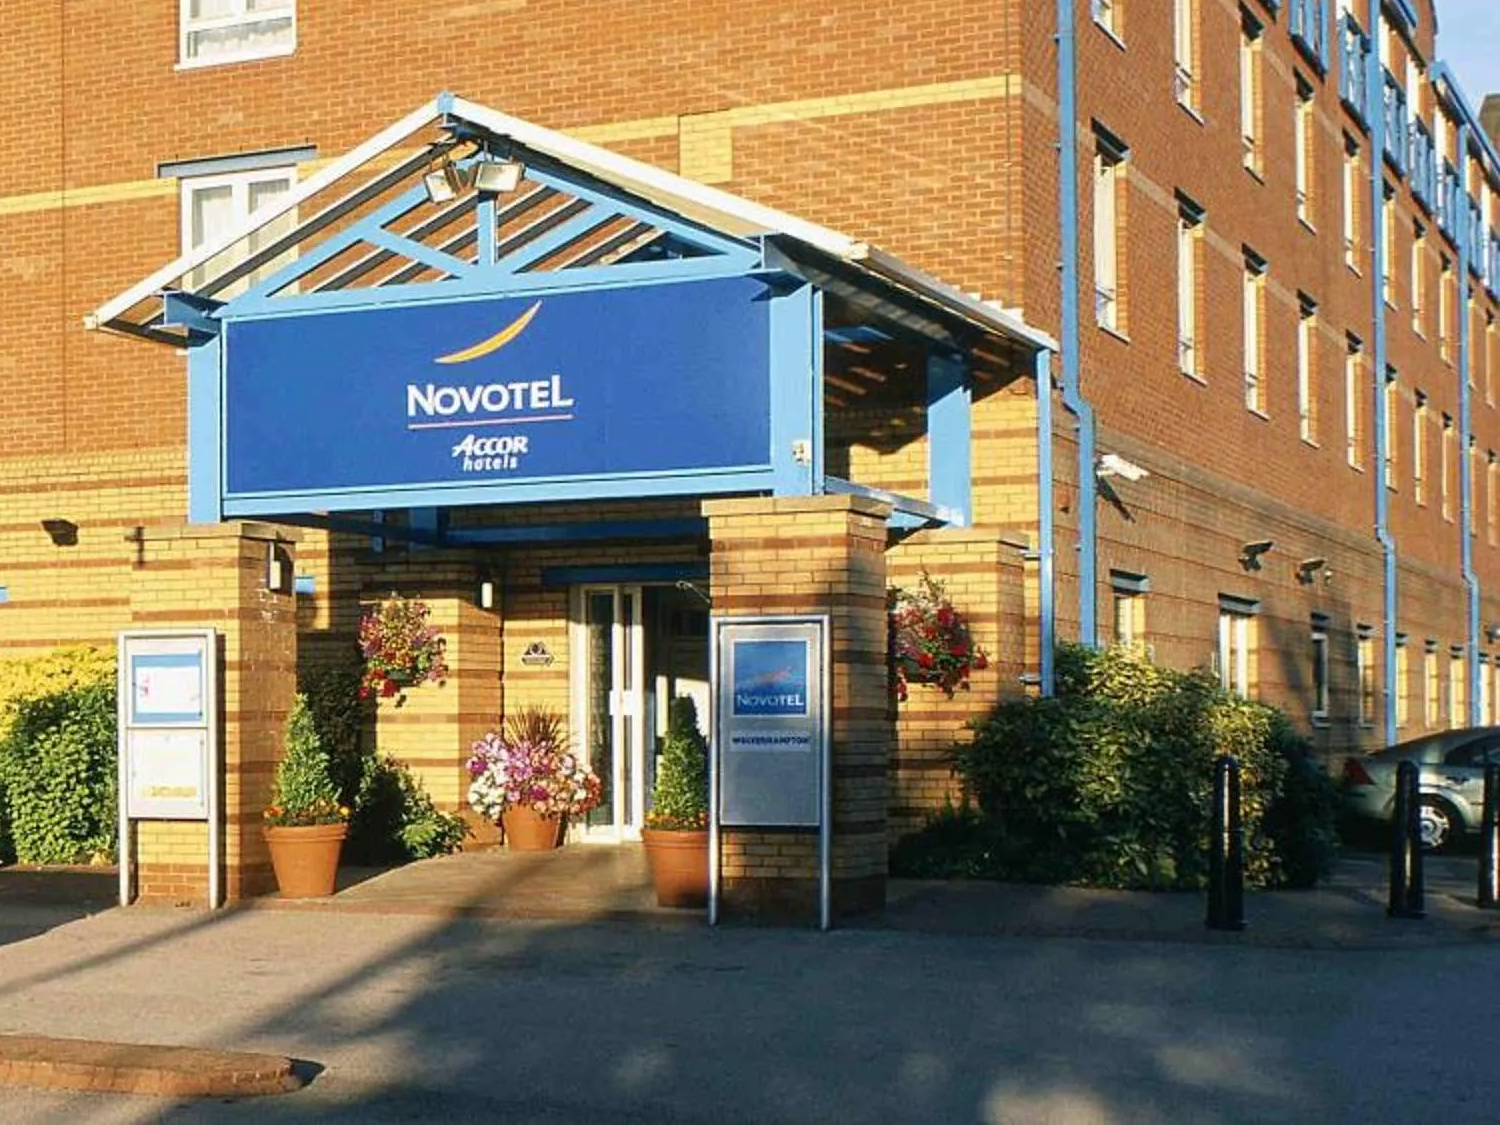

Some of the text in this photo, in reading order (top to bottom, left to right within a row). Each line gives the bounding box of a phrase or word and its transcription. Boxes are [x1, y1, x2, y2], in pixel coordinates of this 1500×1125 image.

[407, 375, 574, 416] NOVOTEL
[452, 434, 529, 457] ACCOR
[463, 454, 517, 472] hotels
[737, 694, 805, 707] NOVOTEL
